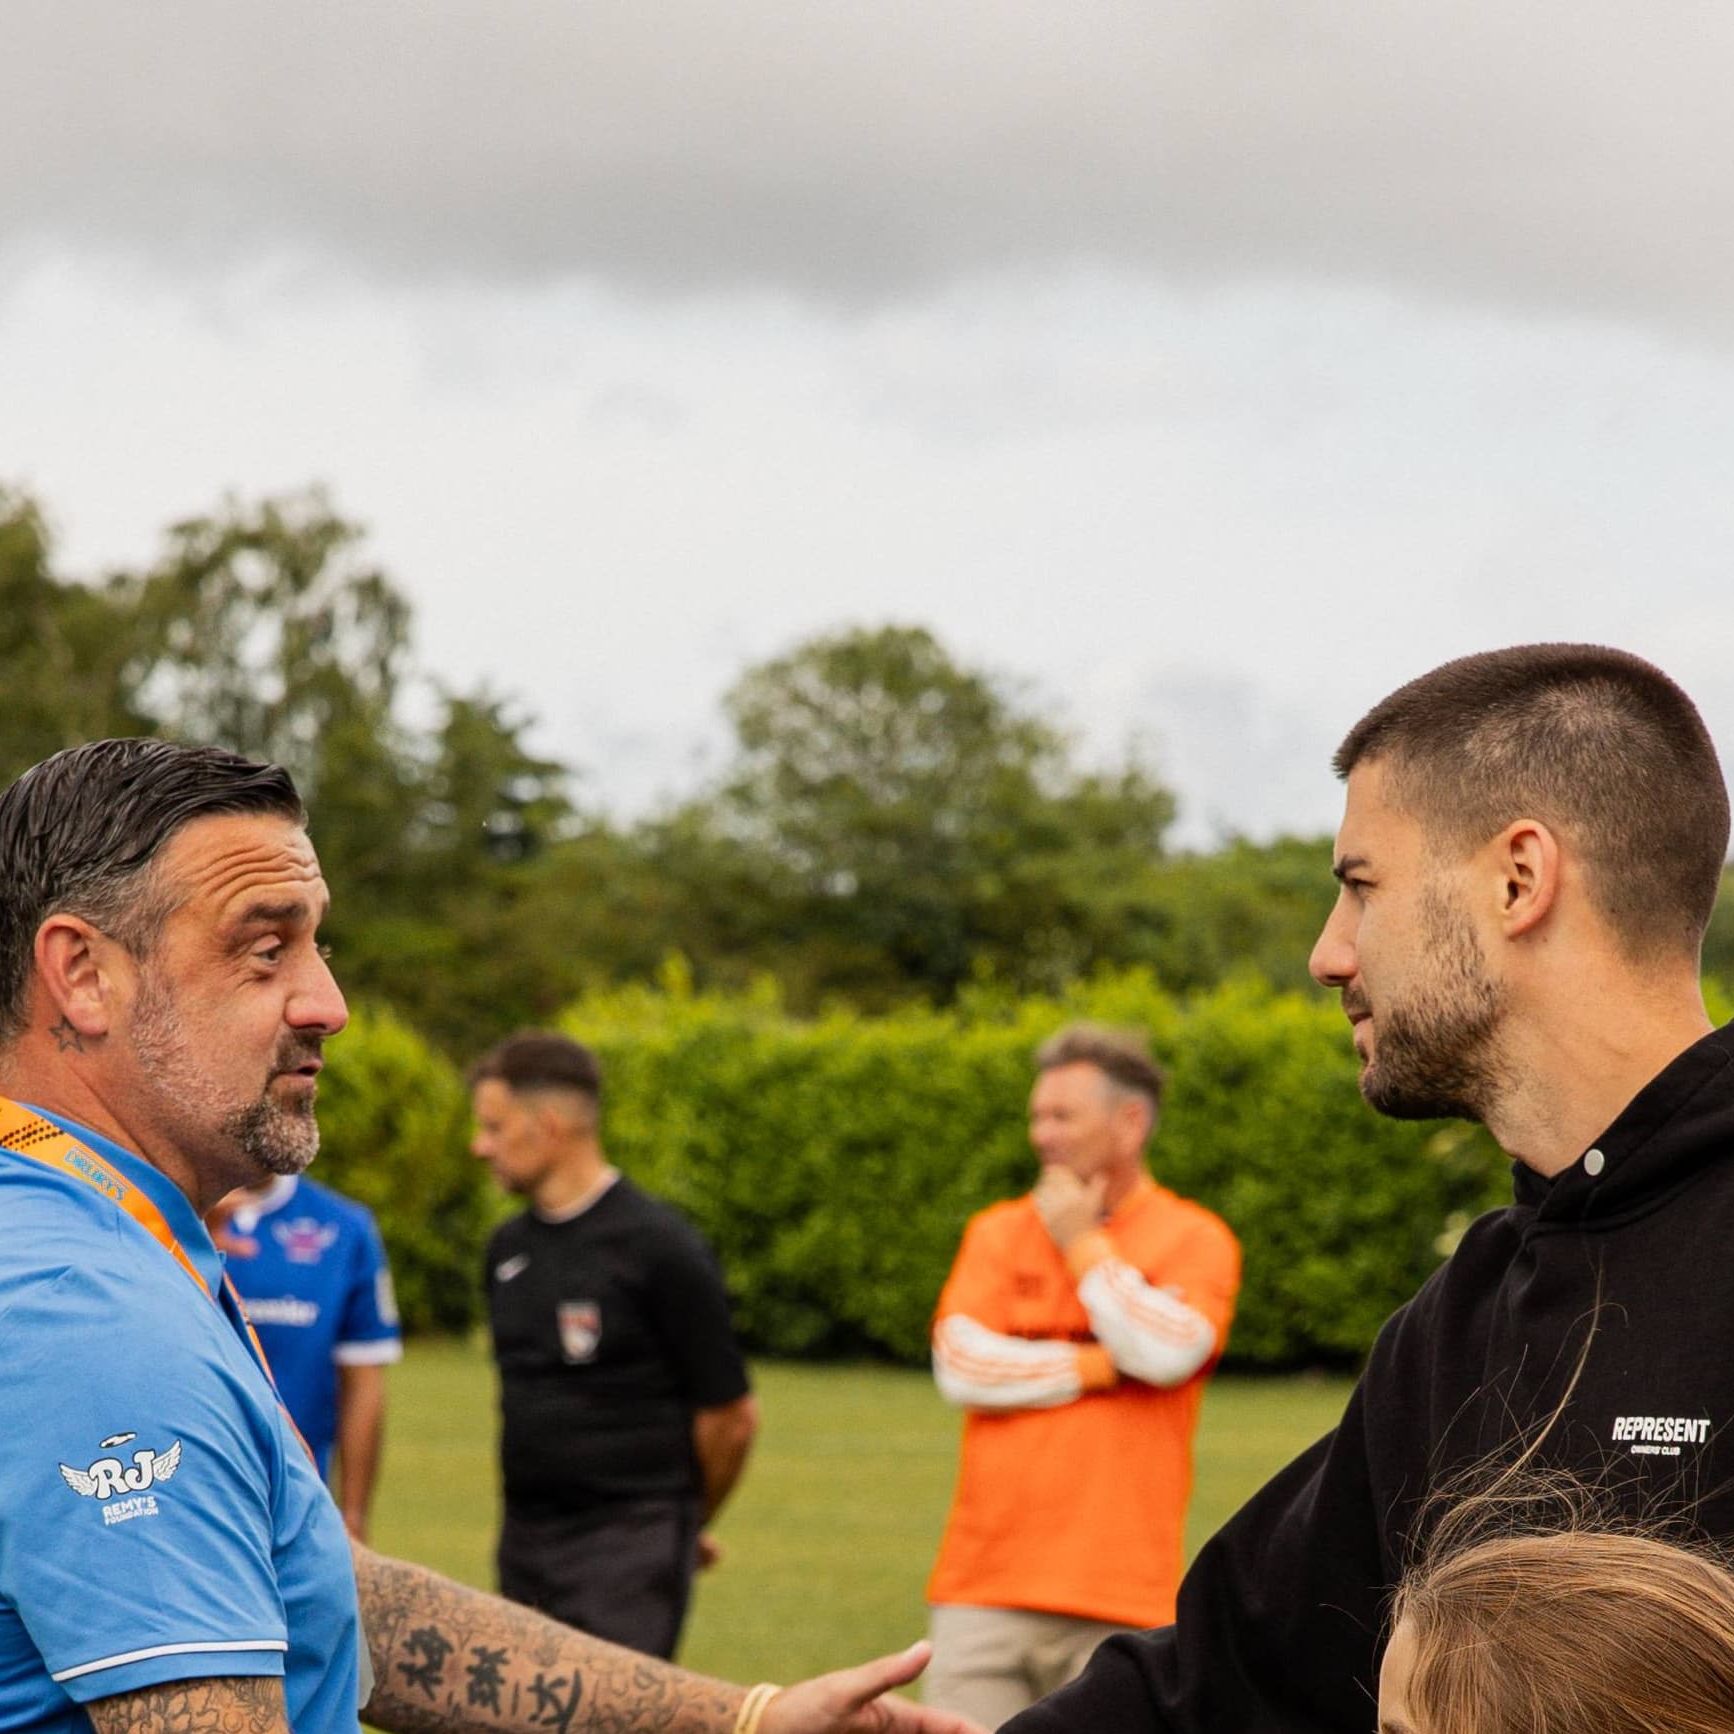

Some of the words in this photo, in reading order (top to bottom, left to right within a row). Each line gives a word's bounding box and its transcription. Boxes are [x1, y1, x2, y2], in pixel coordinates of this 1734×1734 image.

[1611, 1416, 1711, 1443] REPRESENT
[87, 1449, 157, 1500] RJ
[103, 1496, 156, 1517] REMY'S
